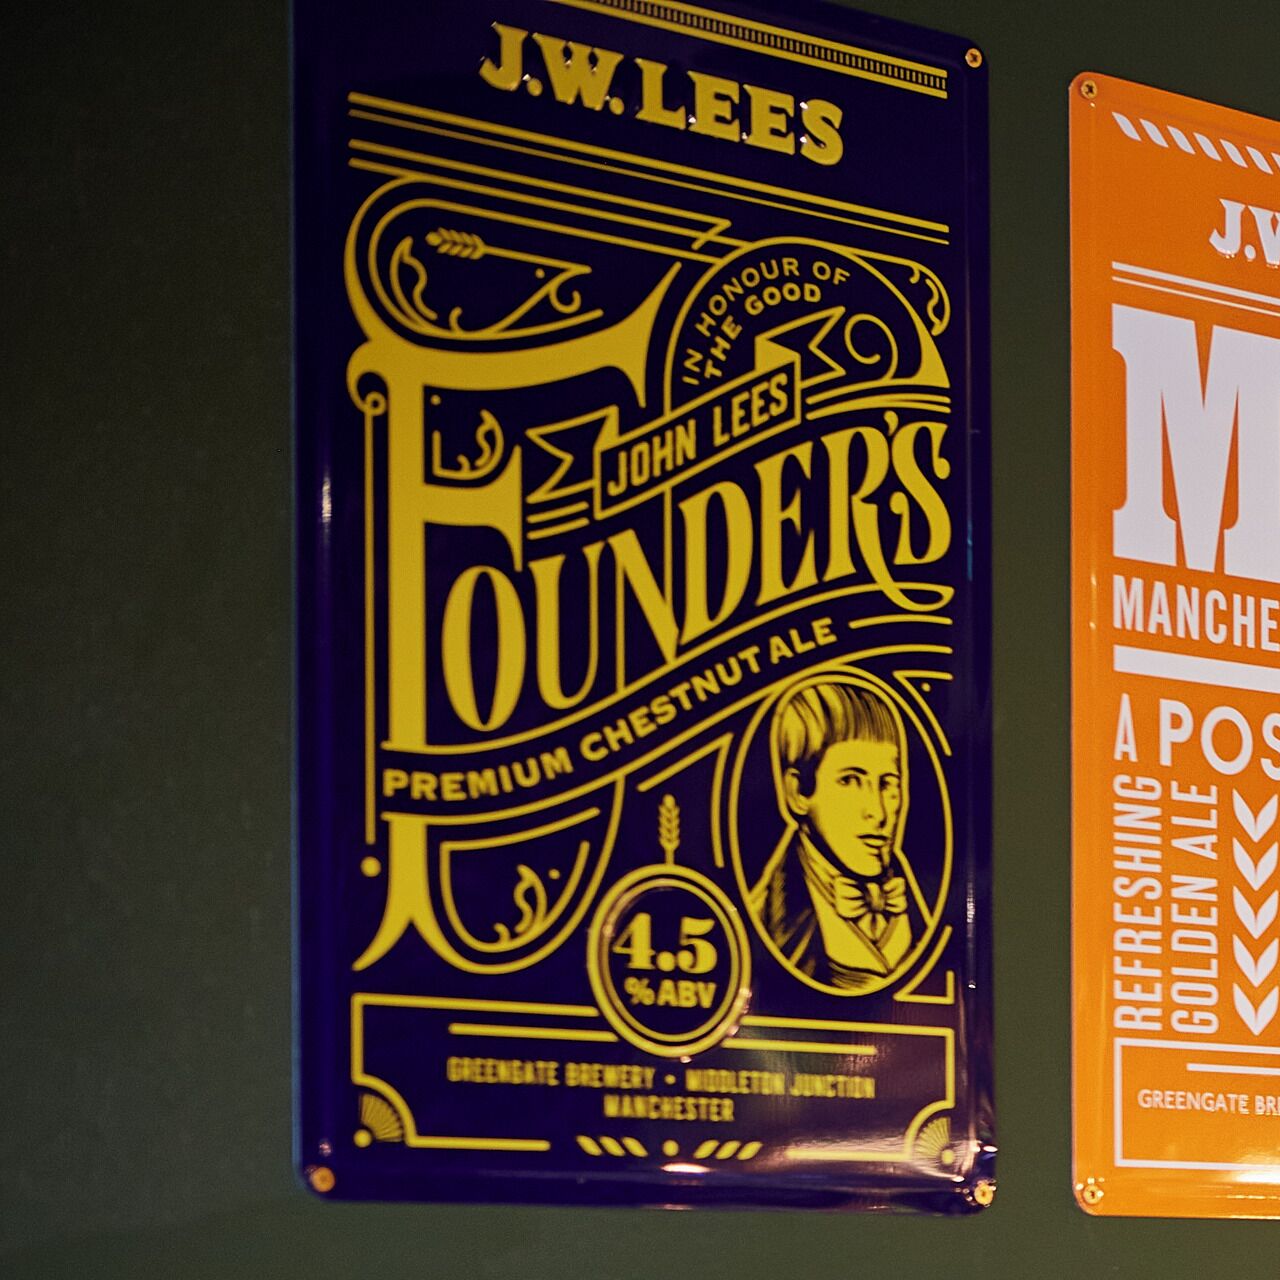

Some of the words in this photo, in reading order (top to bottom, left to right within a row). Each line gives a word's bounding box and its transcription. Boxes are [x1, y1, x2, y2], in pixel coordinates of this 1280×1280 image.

[479, 21, 844, 166] J.W.LEES
[682, 348, 701, 384] IN
[696, 257, 801, 340] HONOUR
[811, 260, 851, 287] OF
[704, 320, 744, 379] THE
[746, 282, 822, 316] GOOD
[607, 417, 697, 497] JOHN
[712, 373, 790, 440] LEES
[382, 747, 574, 802] PREMIUM
[581, 655, 762, 762] CHESTNUT
[769, 617, 838, 664] ALE
[1113, 693, 1138, 762] A
[1171, 784, 1219, 860] ALE
[612, 911, 718, 975] 4.5
[1113, 774, 1162, 1031] REFRESHING
[1171, 875, 1219, 1034] GOLDEN
[446, 1055, 560, 1087] GREENGATE
[566, 1061, 656, 1090] BREWERY
[686, 1066, 785, 1098] MIDDLETON
[790, 1071, 875, 1101] JUNCTION
[604, 1094, 734, 1122] MANCHESTER
[1137, 1088, 1249, 1114] GREENGATE
